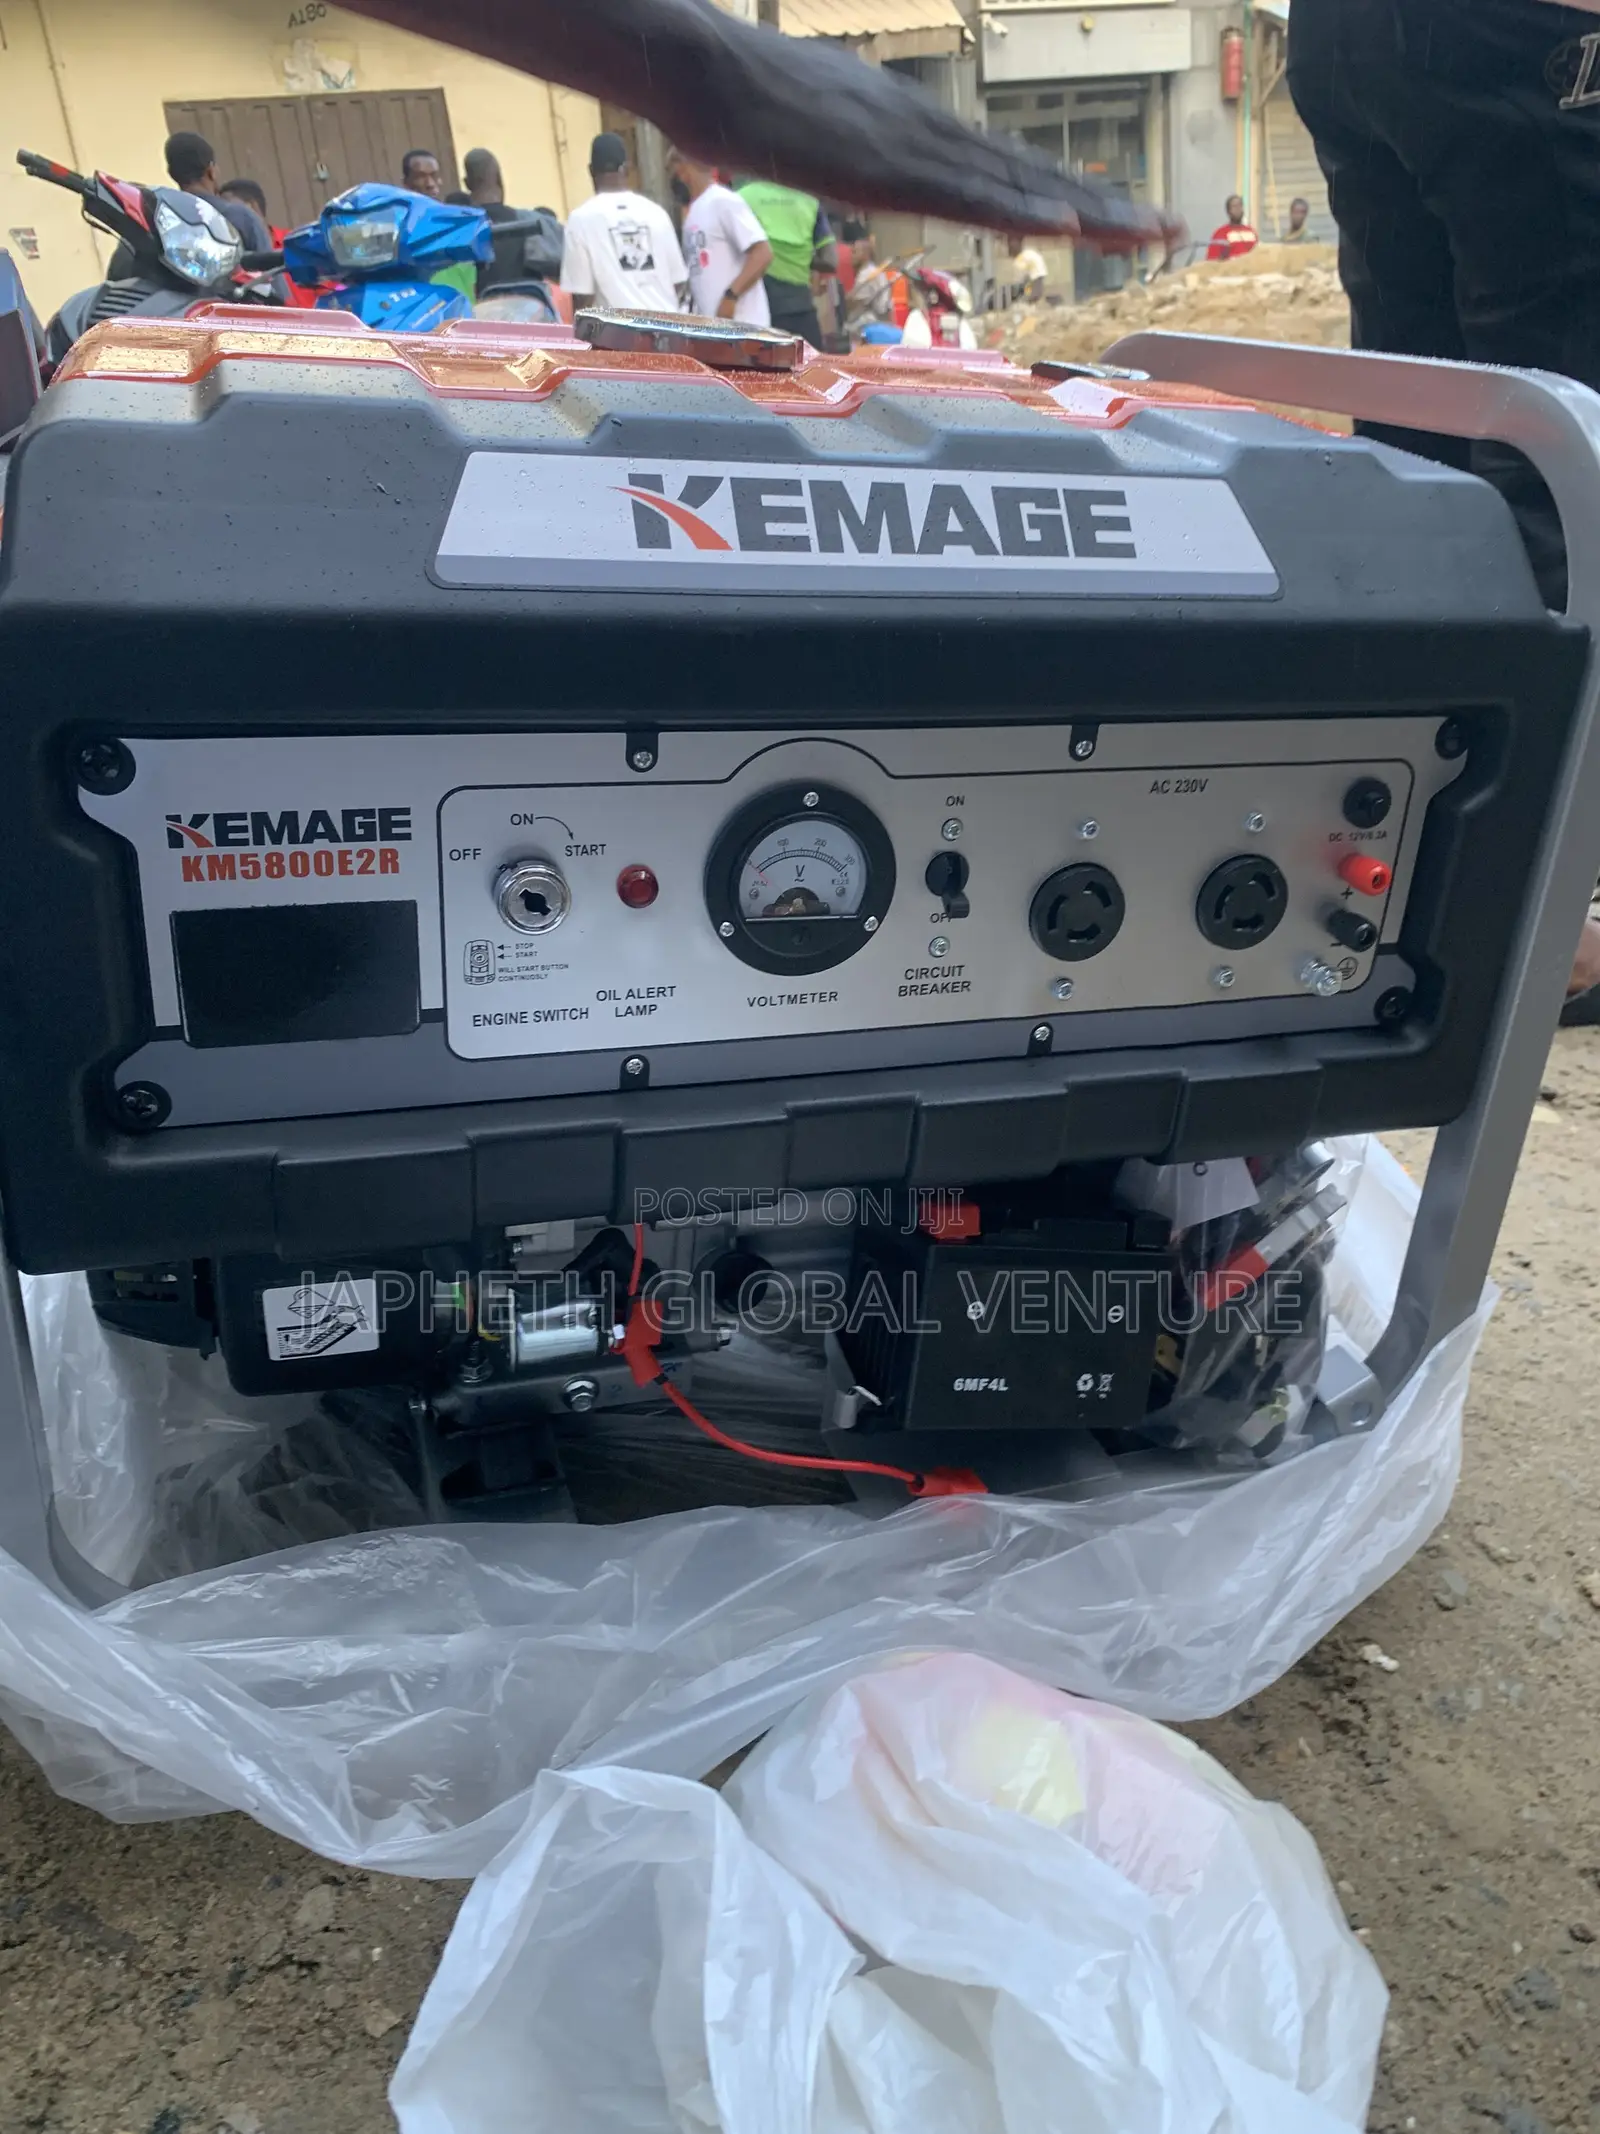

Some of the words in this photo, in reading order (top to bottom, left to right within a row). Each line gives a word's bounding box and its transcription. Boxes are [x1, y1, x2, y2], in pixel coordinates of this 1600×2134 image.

[607, 471, 1138, 559] KEMAGE
[1149, 779, 1171, 794] AC
[1173, 778, 1209, 794] 230V
[945, 795, 966, 807] ON
[510, 813, 535, 826] ON
[165, 806, 413, 849] KEMAGE
[813, 837, 828, 848] 200
[449, 848, 482, 862] OFF
[564, 843, 607, 858] START
[181, 847, 401, 883] KM5800E2R
[794, 864, 806, 878] V
[515, 942, 535, 950] STOP
[515, 951, 539, 959] START
[516, 964, 540, 973] START
[540, 963, 569, 972] BUTTON
[904, 964, 966, 981] CIRCUIT
[596, 989, 622, 1002] OIL
[625, 985, 677, 1000] ALERT
[898, 980, 972, 997] BREAKER
[747, 991, 839, 1008] VOLTMETER
[472, 1010, 529, 1027] ENGINE
[532, 1007, 590, 1024] SWITCH
[615, 1004, 658, 1018] LAMP
